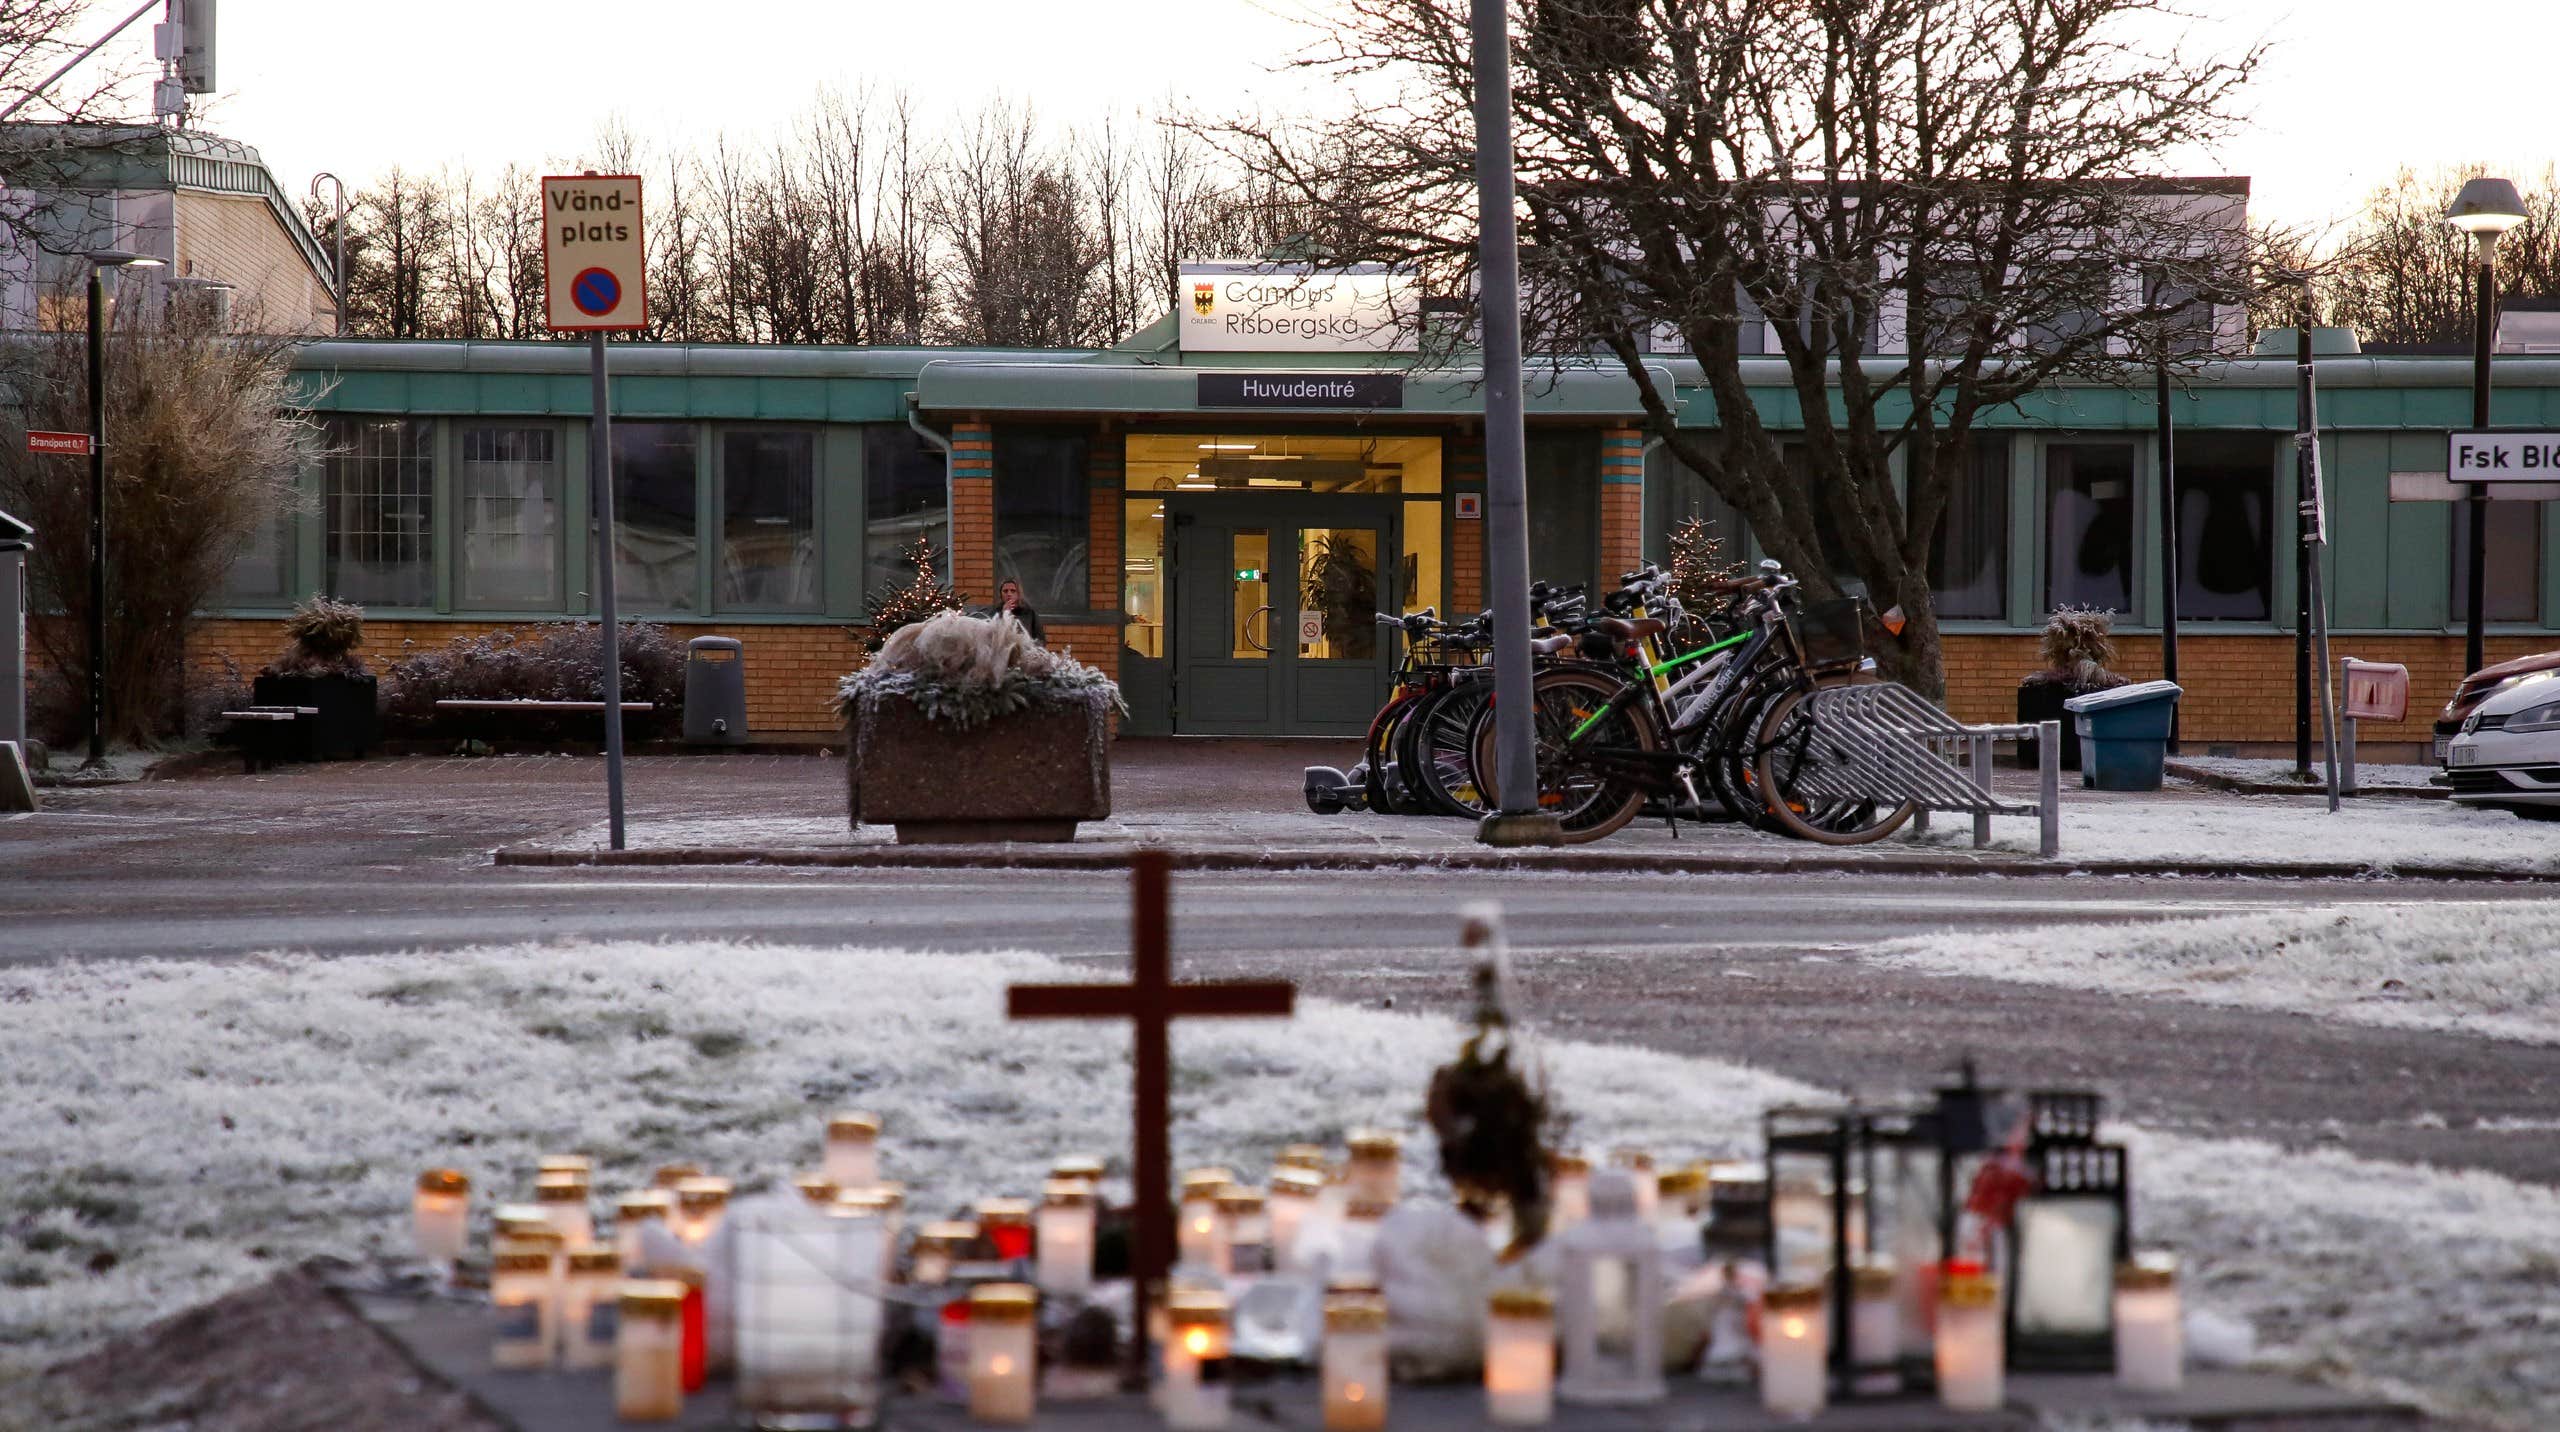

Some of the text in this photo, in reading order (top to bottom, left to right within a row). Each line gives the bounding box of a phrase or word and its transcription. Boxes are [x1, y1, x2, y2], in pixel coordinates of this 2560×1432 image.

[551, 190, 635, 212] Vänd-
[562, 221, 628, 247] plats
[1225, 281, 1333, 306] Campus
[1226, 313, 1358, 339] Risbergska
[1243, 379, 1355, 398] Huvudentré
[31, 436, 71, 449] Brandpost
[2460, 445, 2510, 468] Fsk
